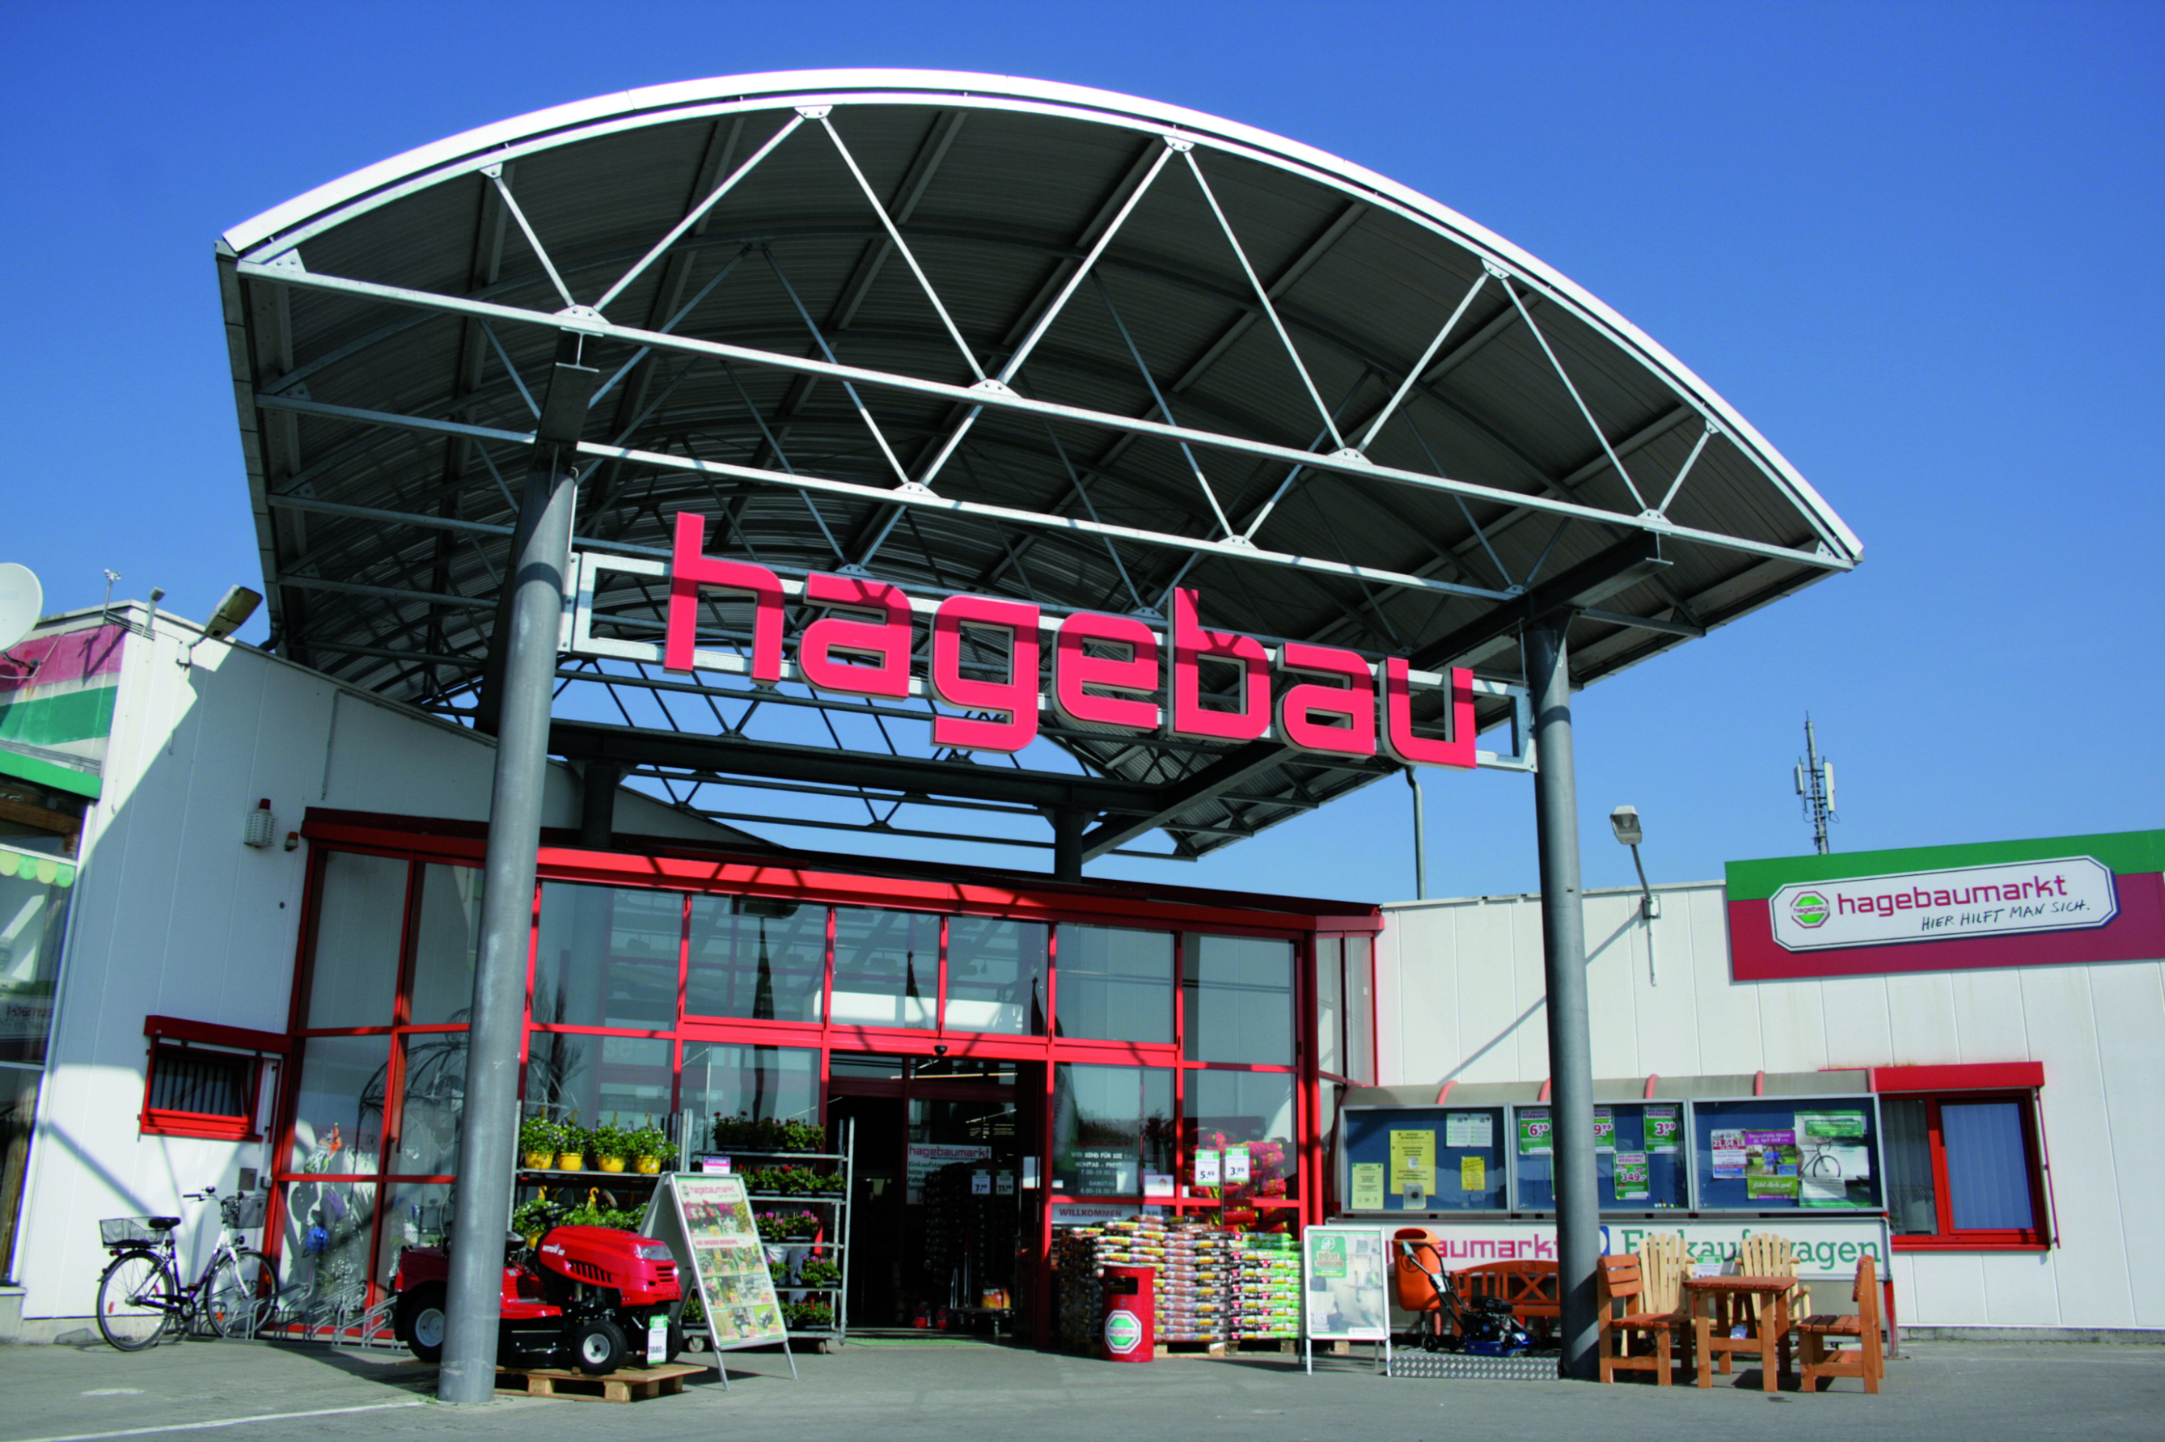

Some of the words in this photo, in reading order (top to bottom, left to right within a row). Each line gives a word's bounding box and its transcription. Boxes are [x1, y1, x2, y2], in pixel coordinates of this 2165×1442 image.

[662, 511, 1478, 770] hagebau
[1837, 875, 2067, 917] hagebaumarkt
[1793, 906, 1828, 914] hagebau
[1921, 915, 1955, 931] HIER
[1960, 908, 2005, 927] HILFT
[2009, 903, 2046, 919] MAN
[2050, 899, 2091, 913] SICH.
[1529, 1123, 1549, 1136] 6.99
[1655, 1122, 1676, 1135] 3.99
[908, 1144, 990, 1158] hagebaumarkt
[1100, 1151, 1111, 1159] FÜR
[1200, 1170, 1215, 1180] 5.49
[1230, 1166, 1245, 1176] 3.99
[1059, 1208, 1122, 1218] WILLKOMMEN
